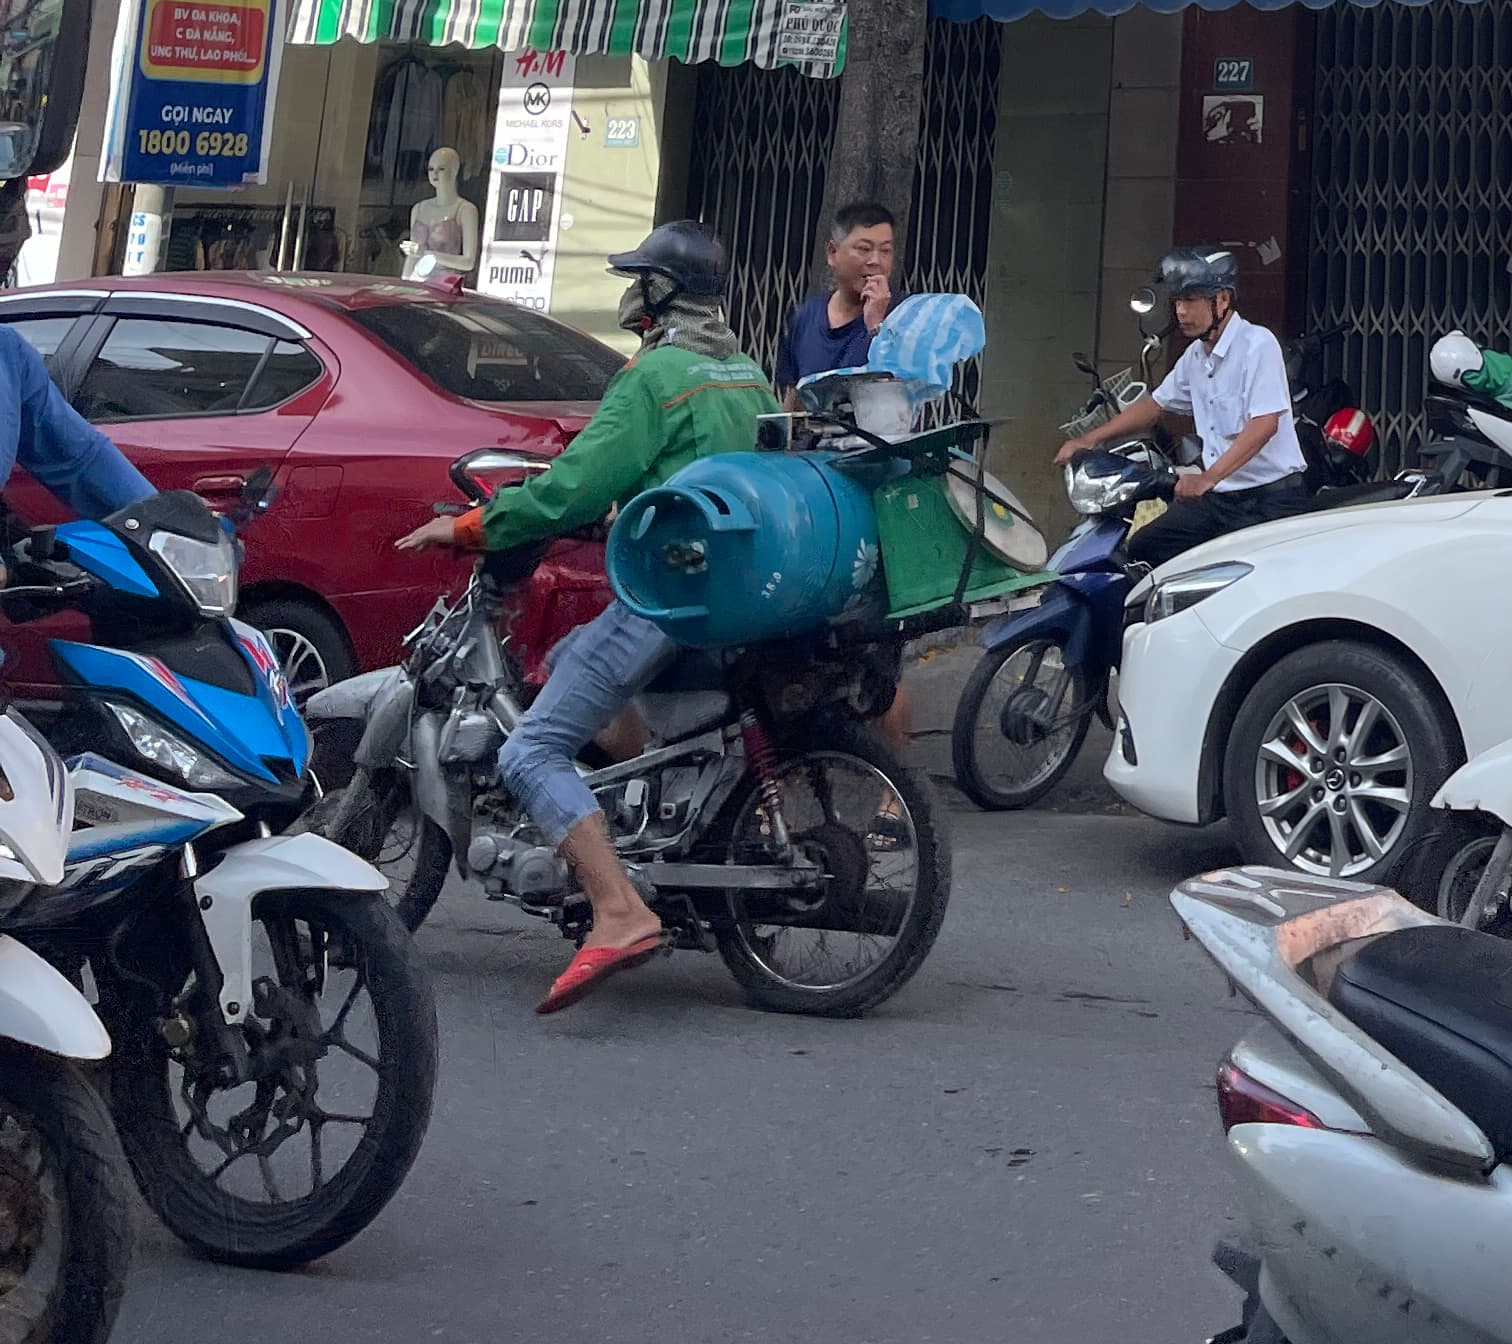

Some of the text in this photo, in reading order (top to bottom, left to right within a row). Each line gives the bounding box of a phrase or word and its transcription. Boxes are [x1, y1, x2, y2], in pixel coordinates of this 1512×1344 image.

[174, 7, 190, 21] BV
[175, 27, 183, 40] C
[200, 49, 222, 62] LAO
[1218, 60, 1250, 82] 227
[161, 104, 234, 127] GỌI NGAY
[540, 118, 564, 129] KORS
[607, 119, 637, 140] 223
[139, 128, 249, 157] 1800 6928
[507, 143, 559, 167] Dior
[507, 187, 544, 223] GAP
[488, 265, 535, 284] PUMA
